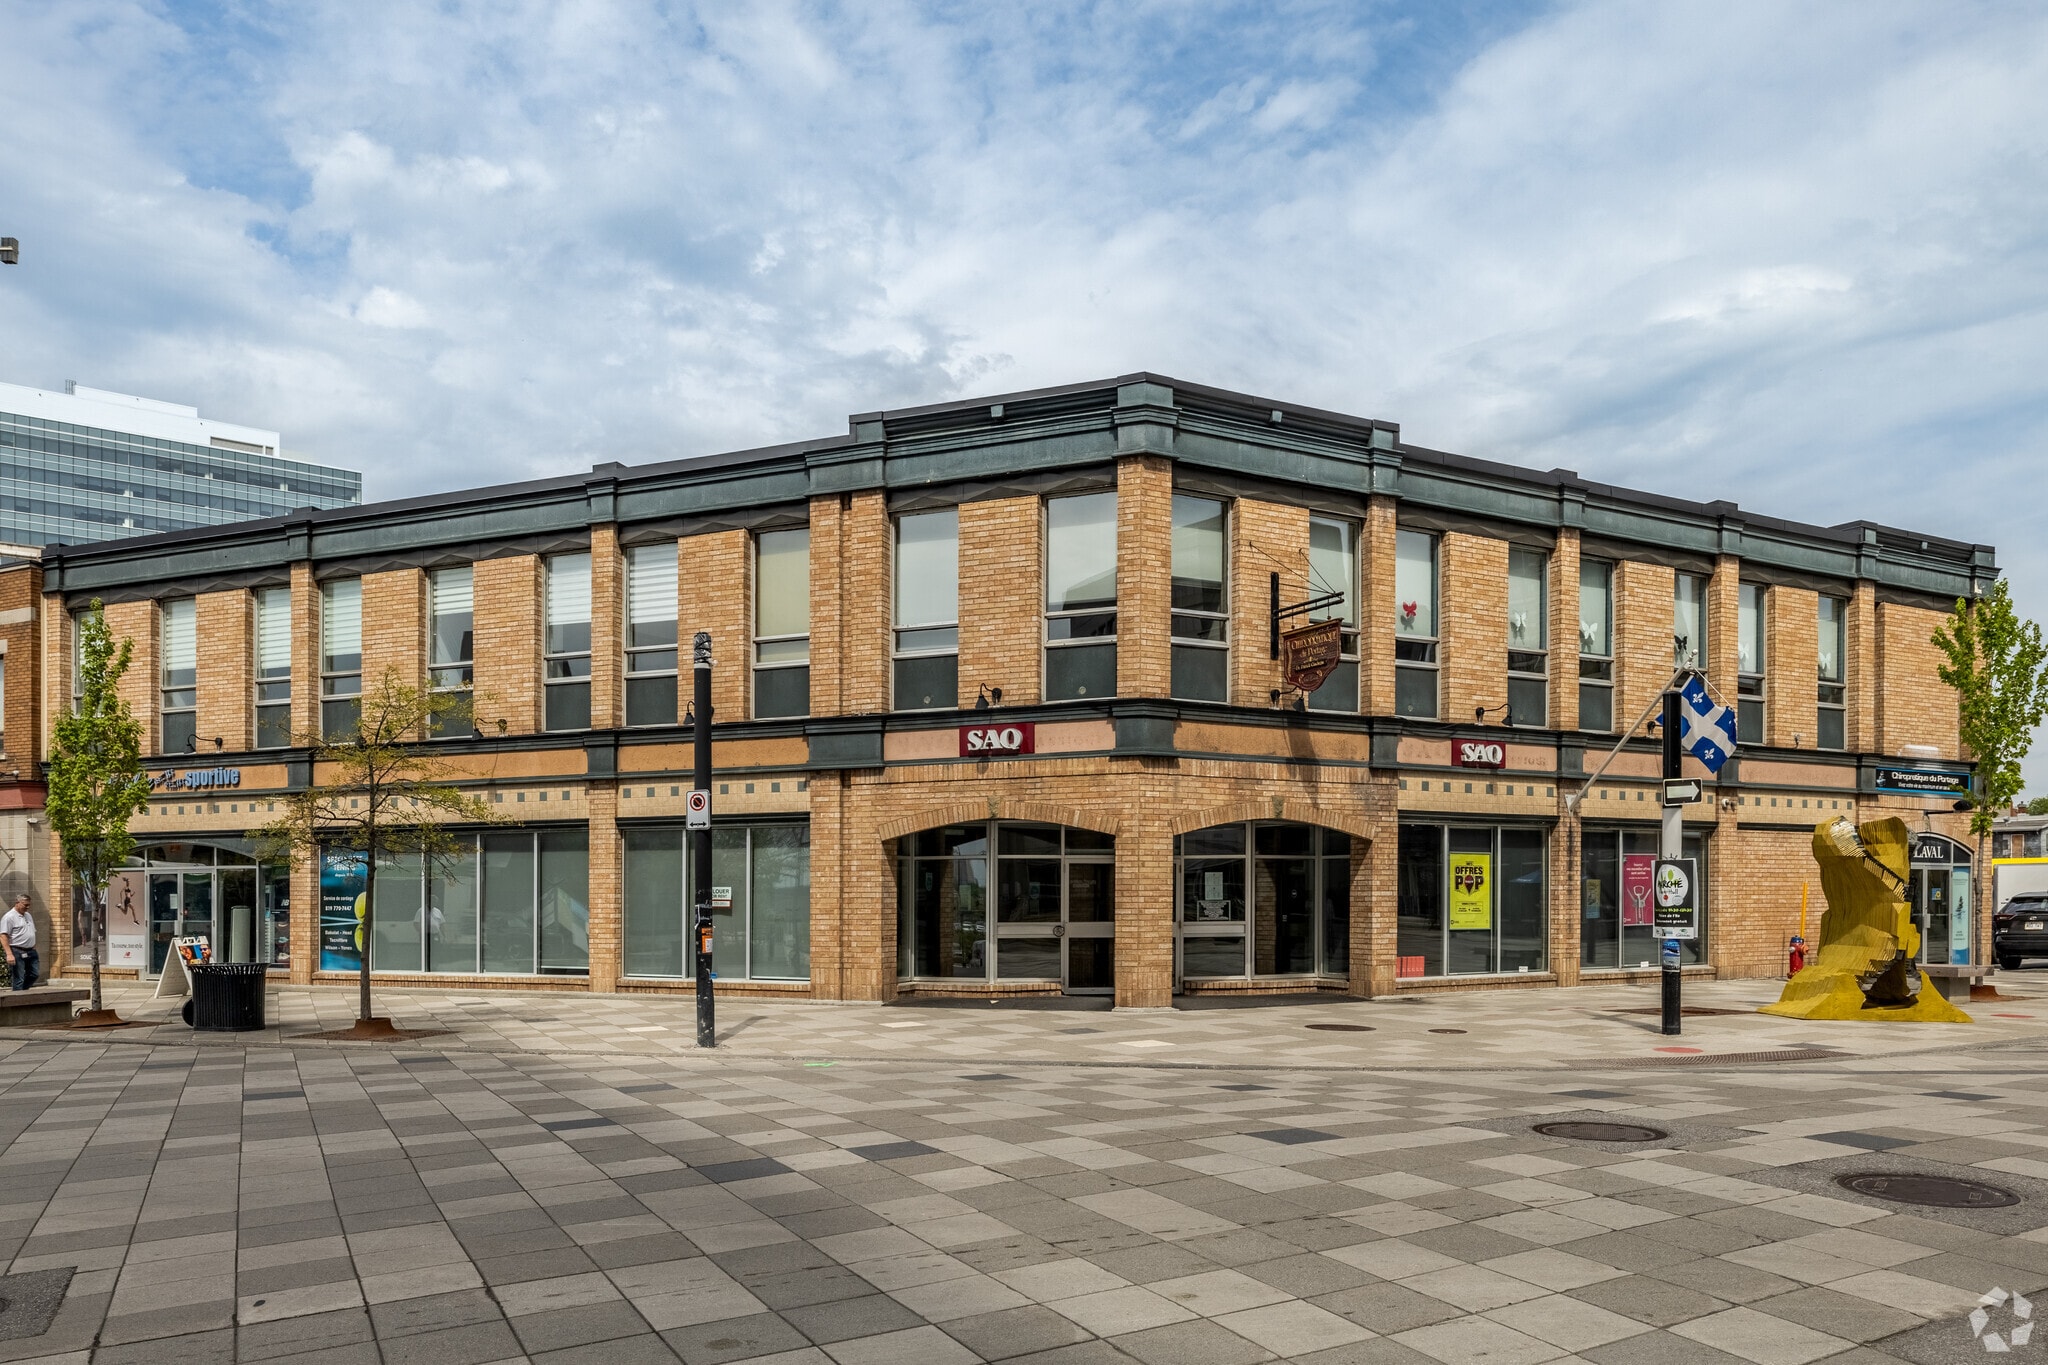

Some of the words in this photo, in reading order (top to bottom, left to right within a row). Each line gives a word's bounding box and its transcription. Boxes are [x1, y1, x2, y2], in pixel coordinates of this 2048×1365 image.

[967, 728, 1023, 750] SAQ
[1461, 743, 1502, 764] SAQ
[184, 767, 240, 787] sportive
[1892, 772, 1928, 783] Chiropratique
[1937, 775, 1959, 784] Portage
[1914, 846, 1944, 858] LAVAL
[1455, 866, 1483, 875] OFFRES
